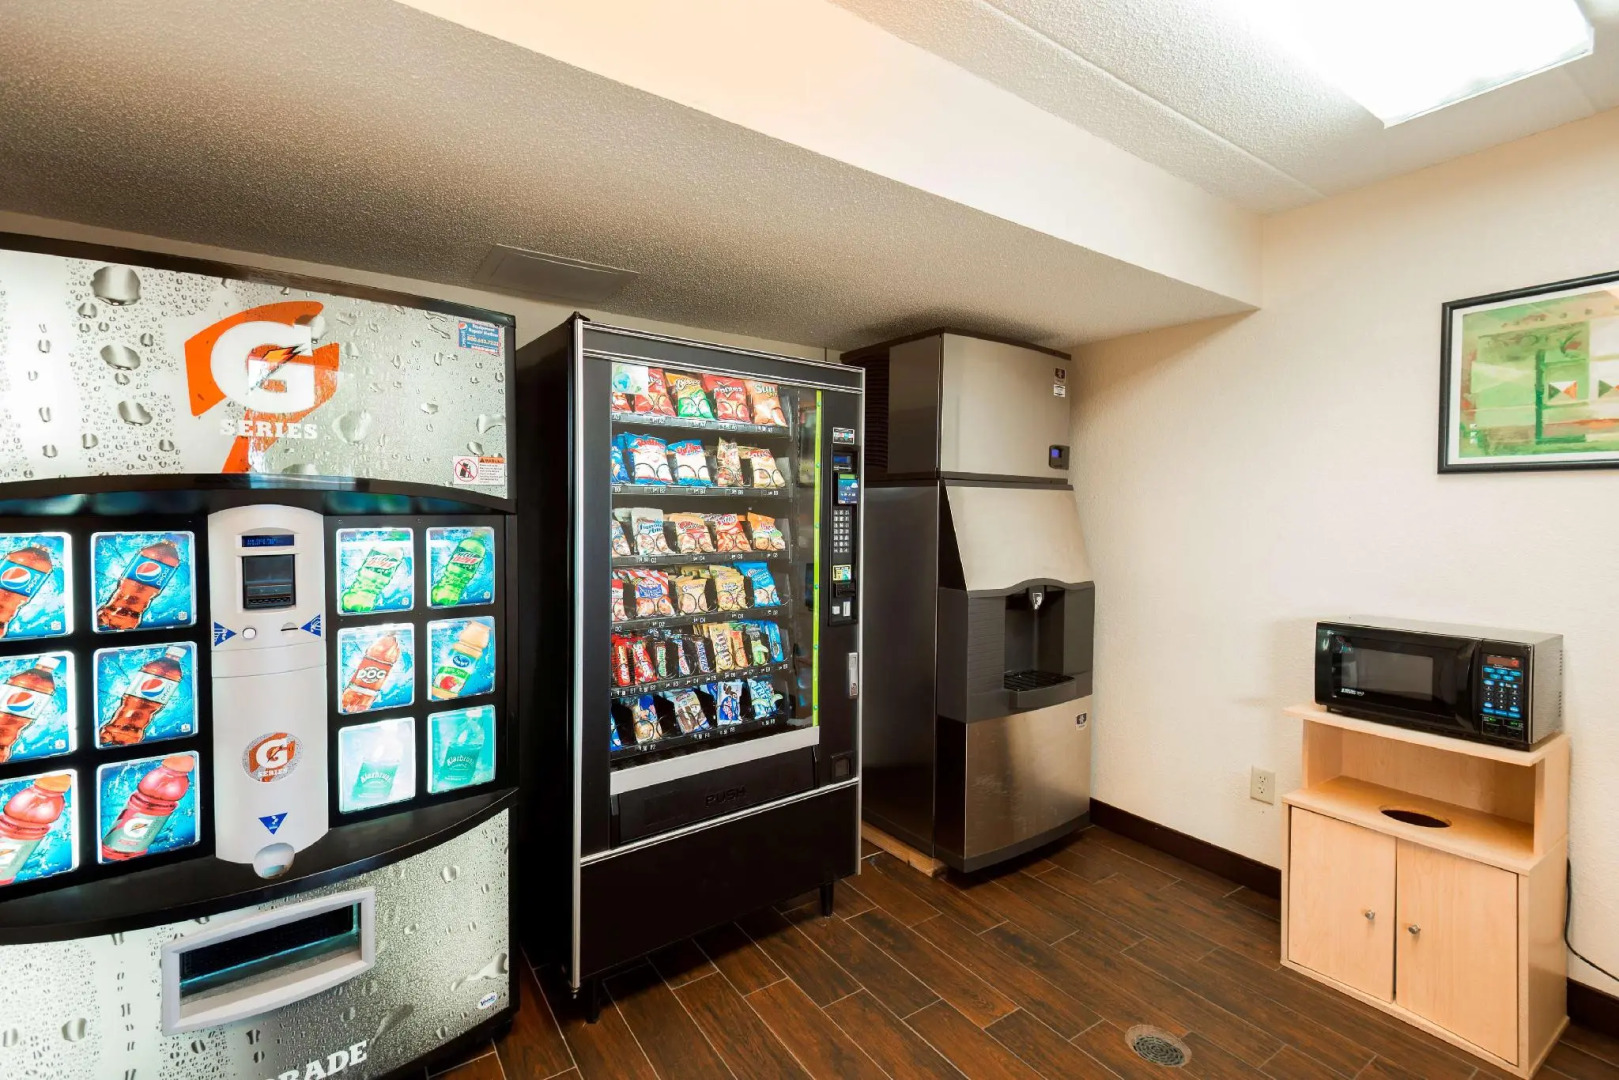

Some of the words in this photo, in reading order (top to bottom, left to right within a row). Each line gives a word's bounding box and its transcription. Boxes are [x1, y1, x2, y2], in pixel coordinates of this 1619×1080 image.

[209, 320, 315, 413] G
[219, 419, 318, 439] SERIES
[704, 785, 746, 808] PUSH
[266, 1040, 368, 1080] RADE
